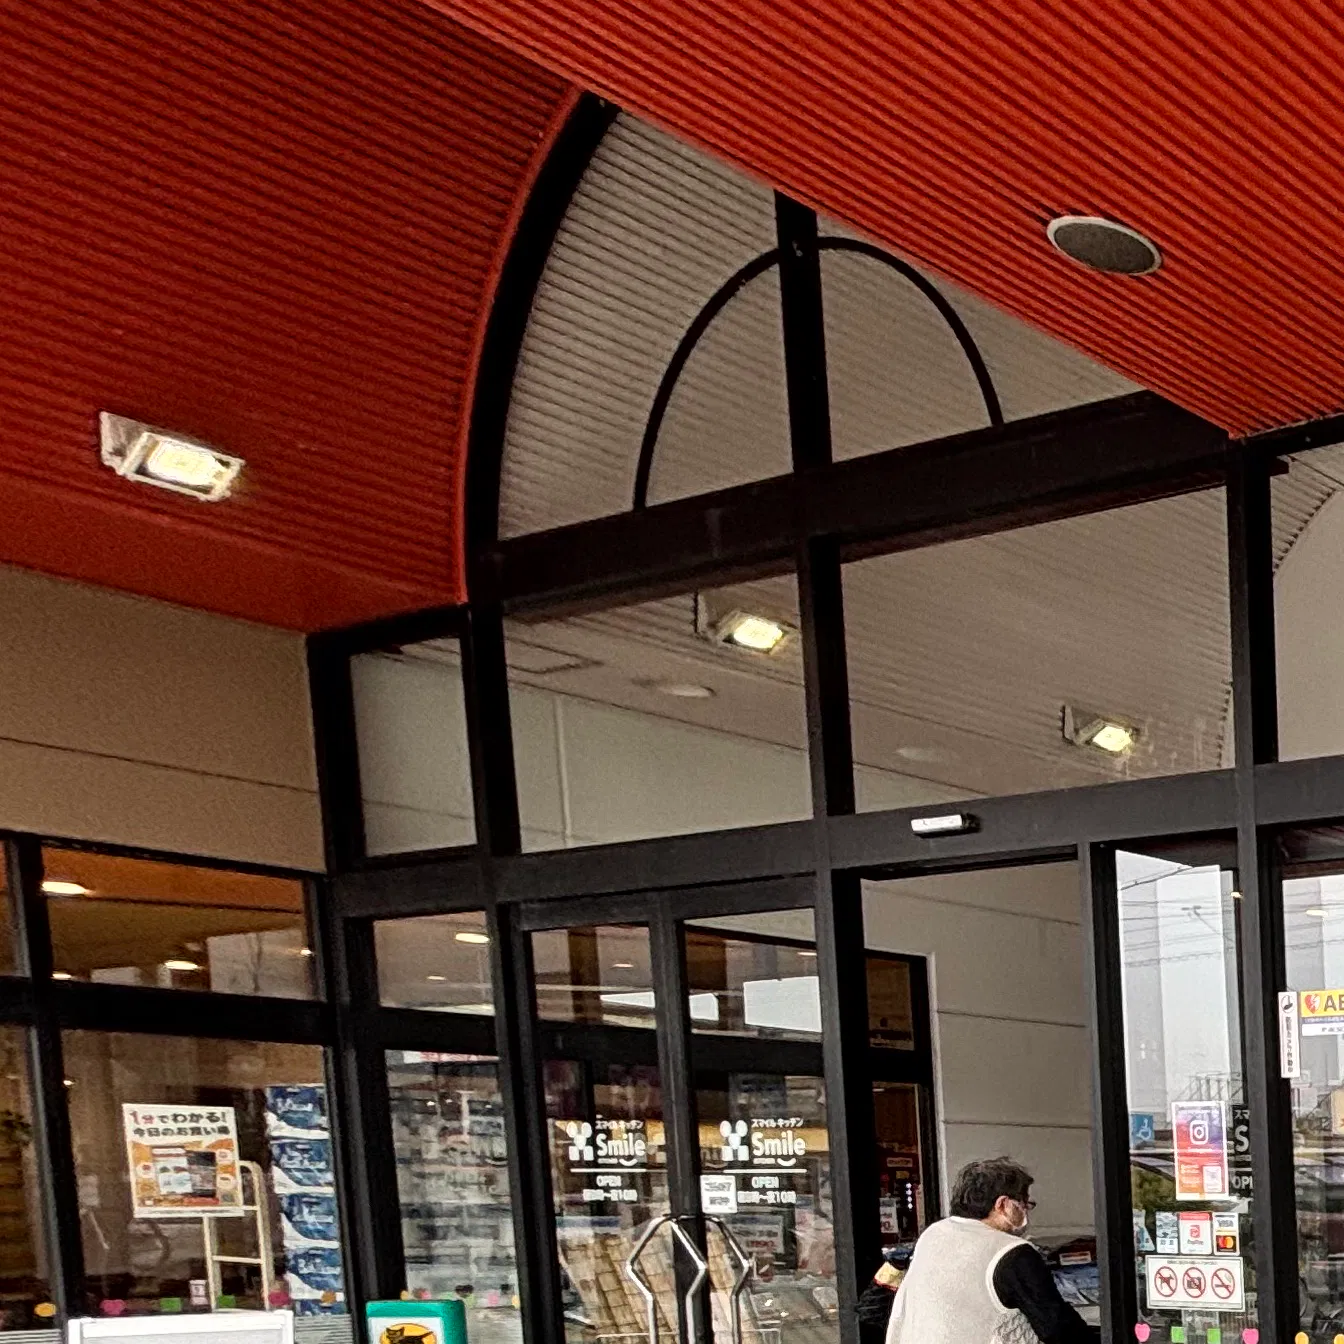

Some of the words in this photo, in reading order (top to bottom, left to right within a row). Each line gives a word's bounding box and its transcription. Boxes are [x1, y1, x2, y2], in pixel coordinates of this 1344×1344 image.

[596, 1132, 646, 1156] Smile
[751, 1130, 806, 1156] Smile
[752, 1176, 780, 1189] OPEN
